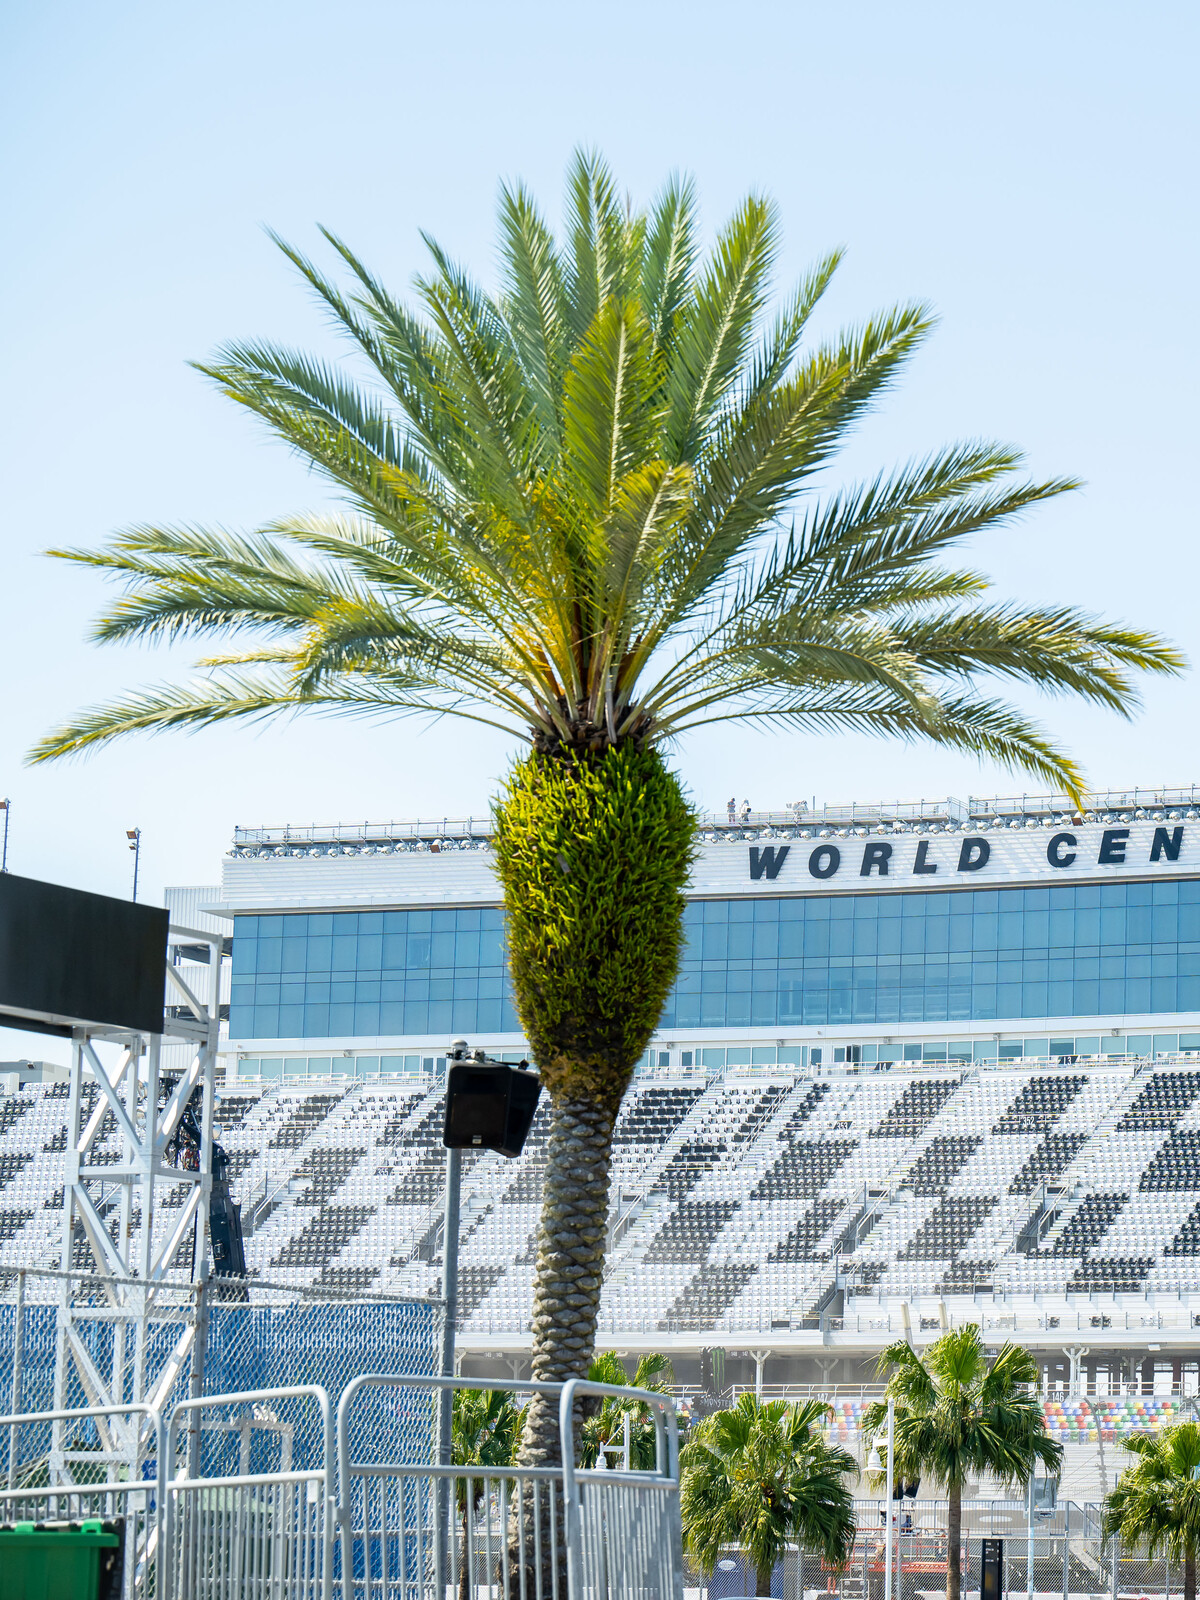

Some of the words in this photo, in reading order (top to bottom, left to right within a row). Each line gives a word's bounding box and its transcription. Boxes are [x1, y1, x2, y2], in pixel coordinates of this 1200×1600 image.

[748, 837, 990, 880] WORLD
[1022, 1116, 1035, 1126] 352
[1051, 1391, 1065, 1403] 146
